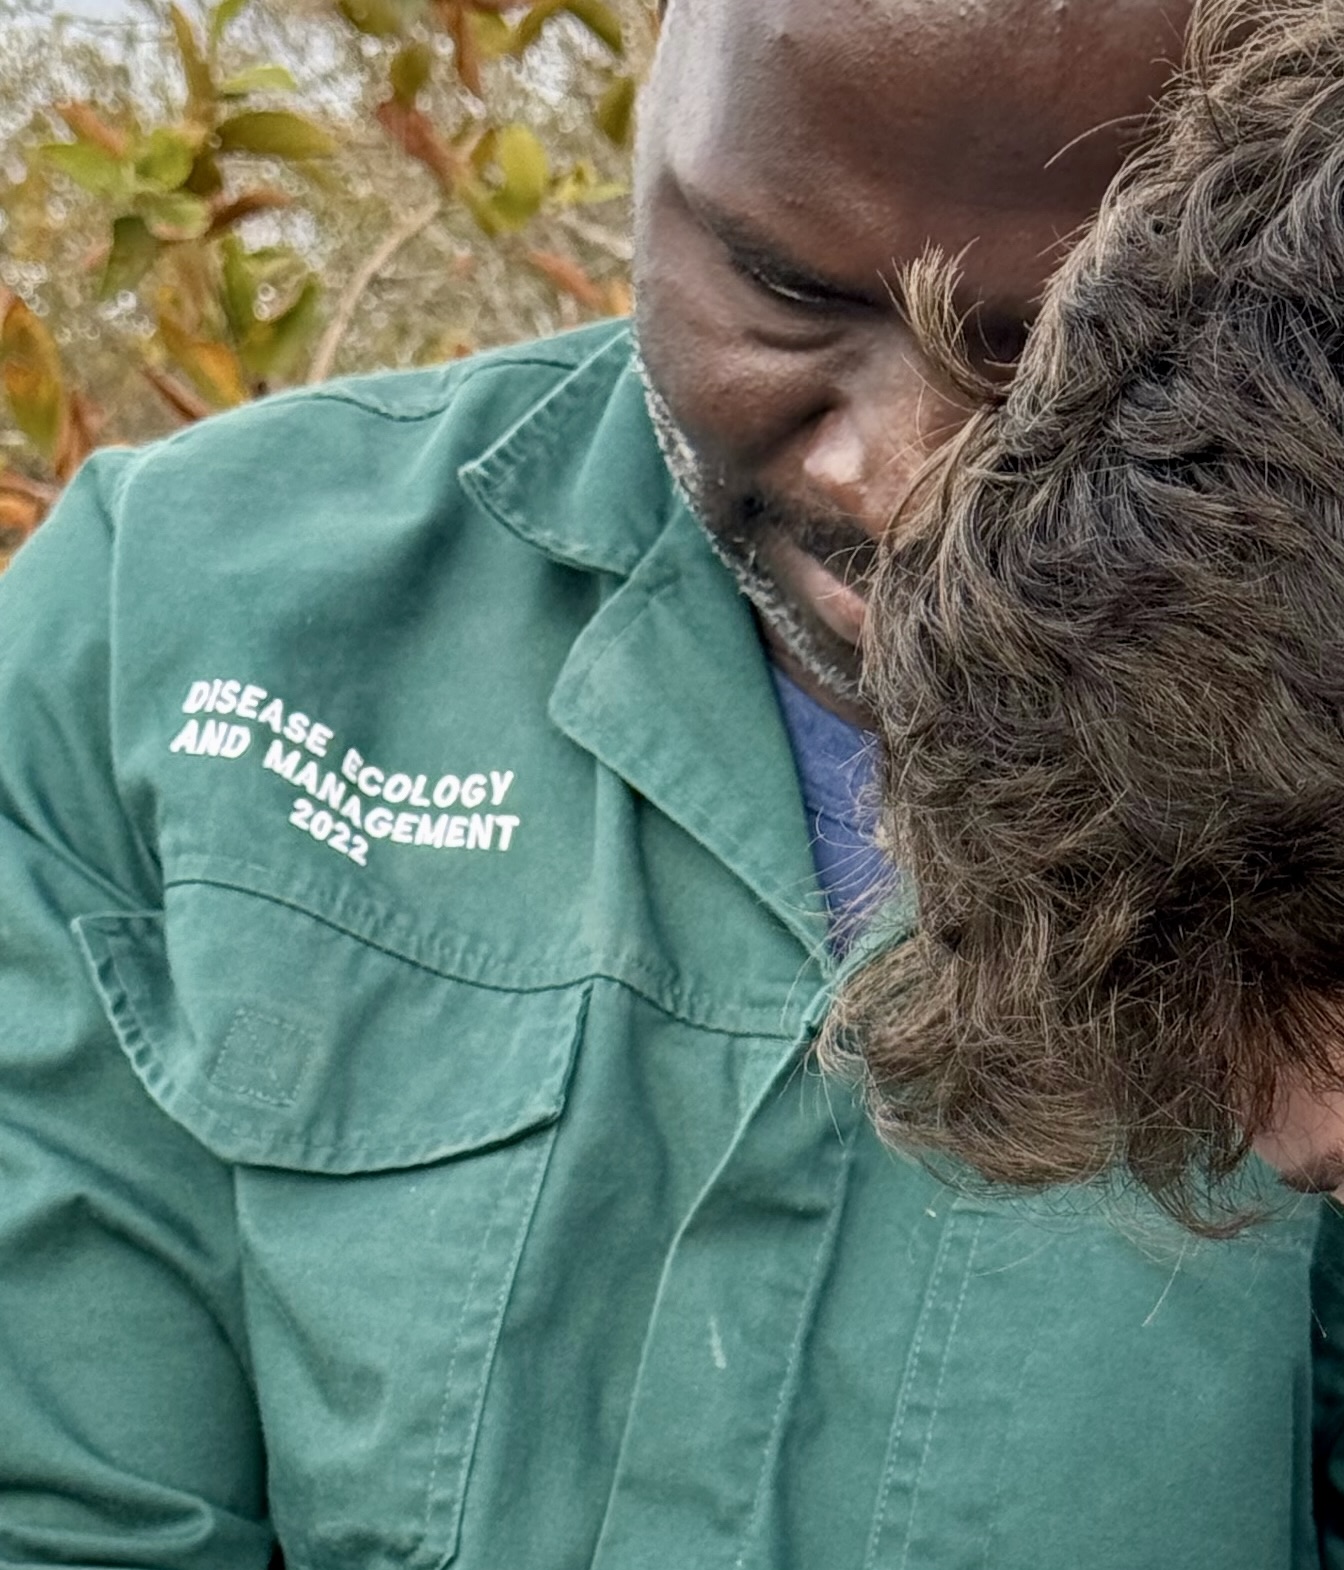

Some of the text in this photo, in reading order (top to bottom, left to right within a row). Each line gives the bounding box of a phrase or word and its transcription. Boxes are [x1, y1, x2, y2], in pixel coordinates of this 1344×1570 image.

[168, 718, 521, 852] AND MANAGEMENT
[181, 678, 516, 809] DISEASE ECOLOGY
[288, 798, 370, 867] 2022
